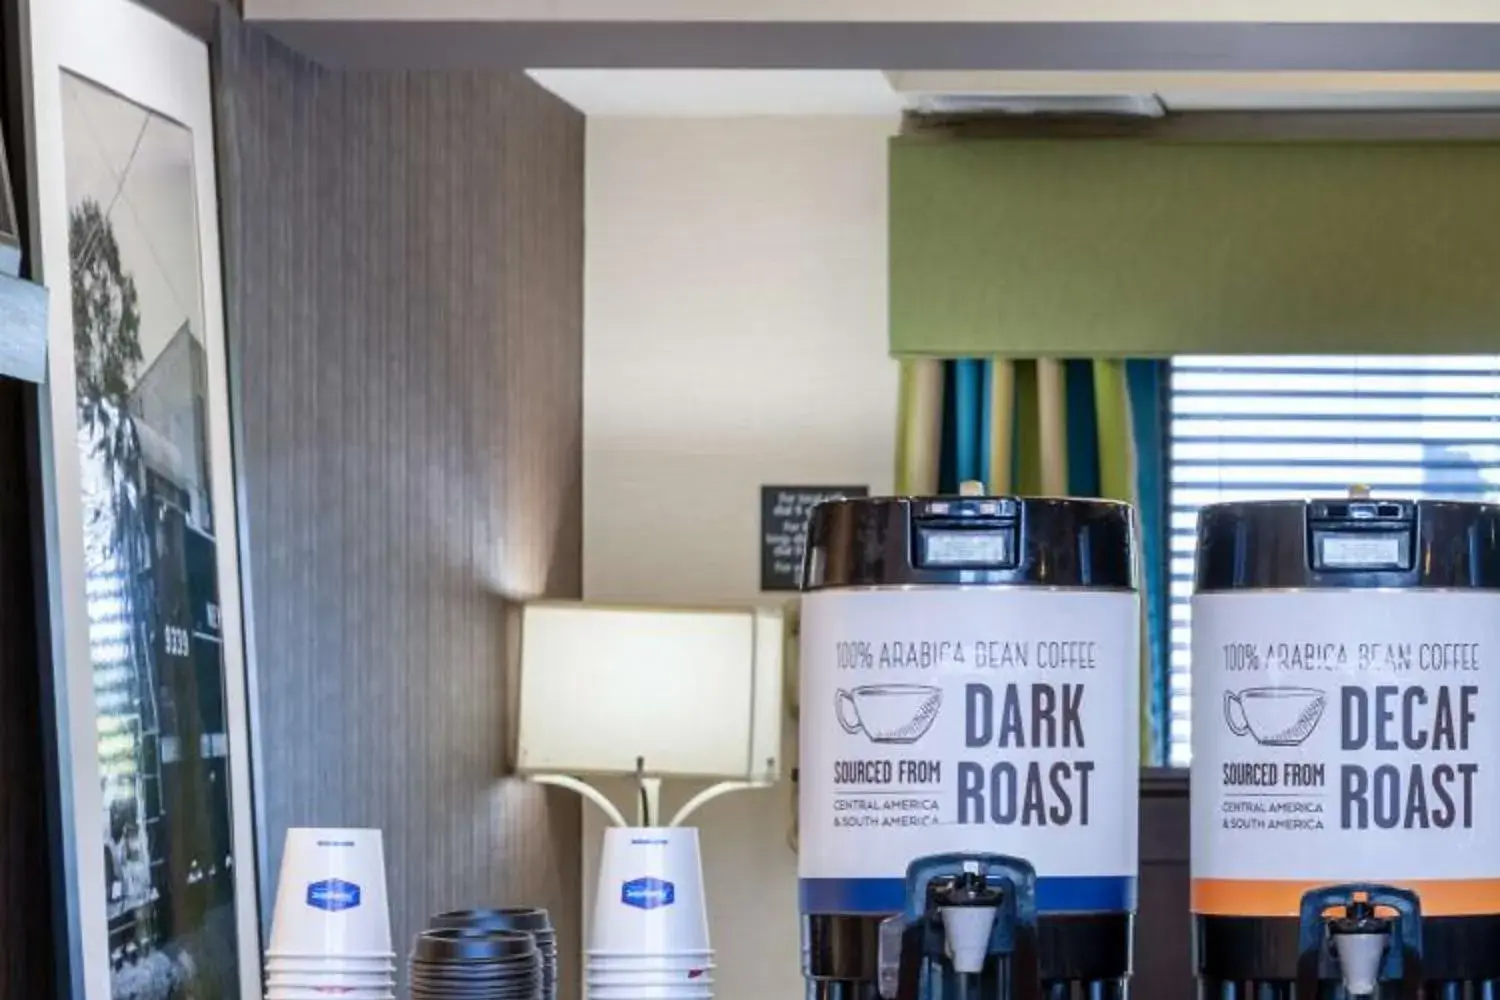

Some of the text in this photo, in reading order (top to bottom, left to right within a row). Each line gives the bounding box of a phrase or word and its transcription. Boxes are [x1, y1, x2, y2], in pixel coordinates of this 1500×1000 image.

[835, 641, 1097, 669] 100% ARABICA BEAN COFFEE
[1222, 643, 1480, 672] 100% ARABICA BEAN COFFEE
[965, 682, 1086, 749] DARK
[1341, 685, 1479, 751] DECAF
[833, 760, 942, 784] SOURCED FROM
[1223, 763, 1325, 787] SOURCED FROM
[833, 799, 940, 811] CENTRAL AMERICA
[957, 761, 1095, 826] ROAST
[1341, 763, 1479, 830] ROAST
[1222, 801, 1324, 813] CENTRAL AMERICA
[882, 815, 939, 827] AMERICA
[1268, 818, 1324, 829] AMERICA
